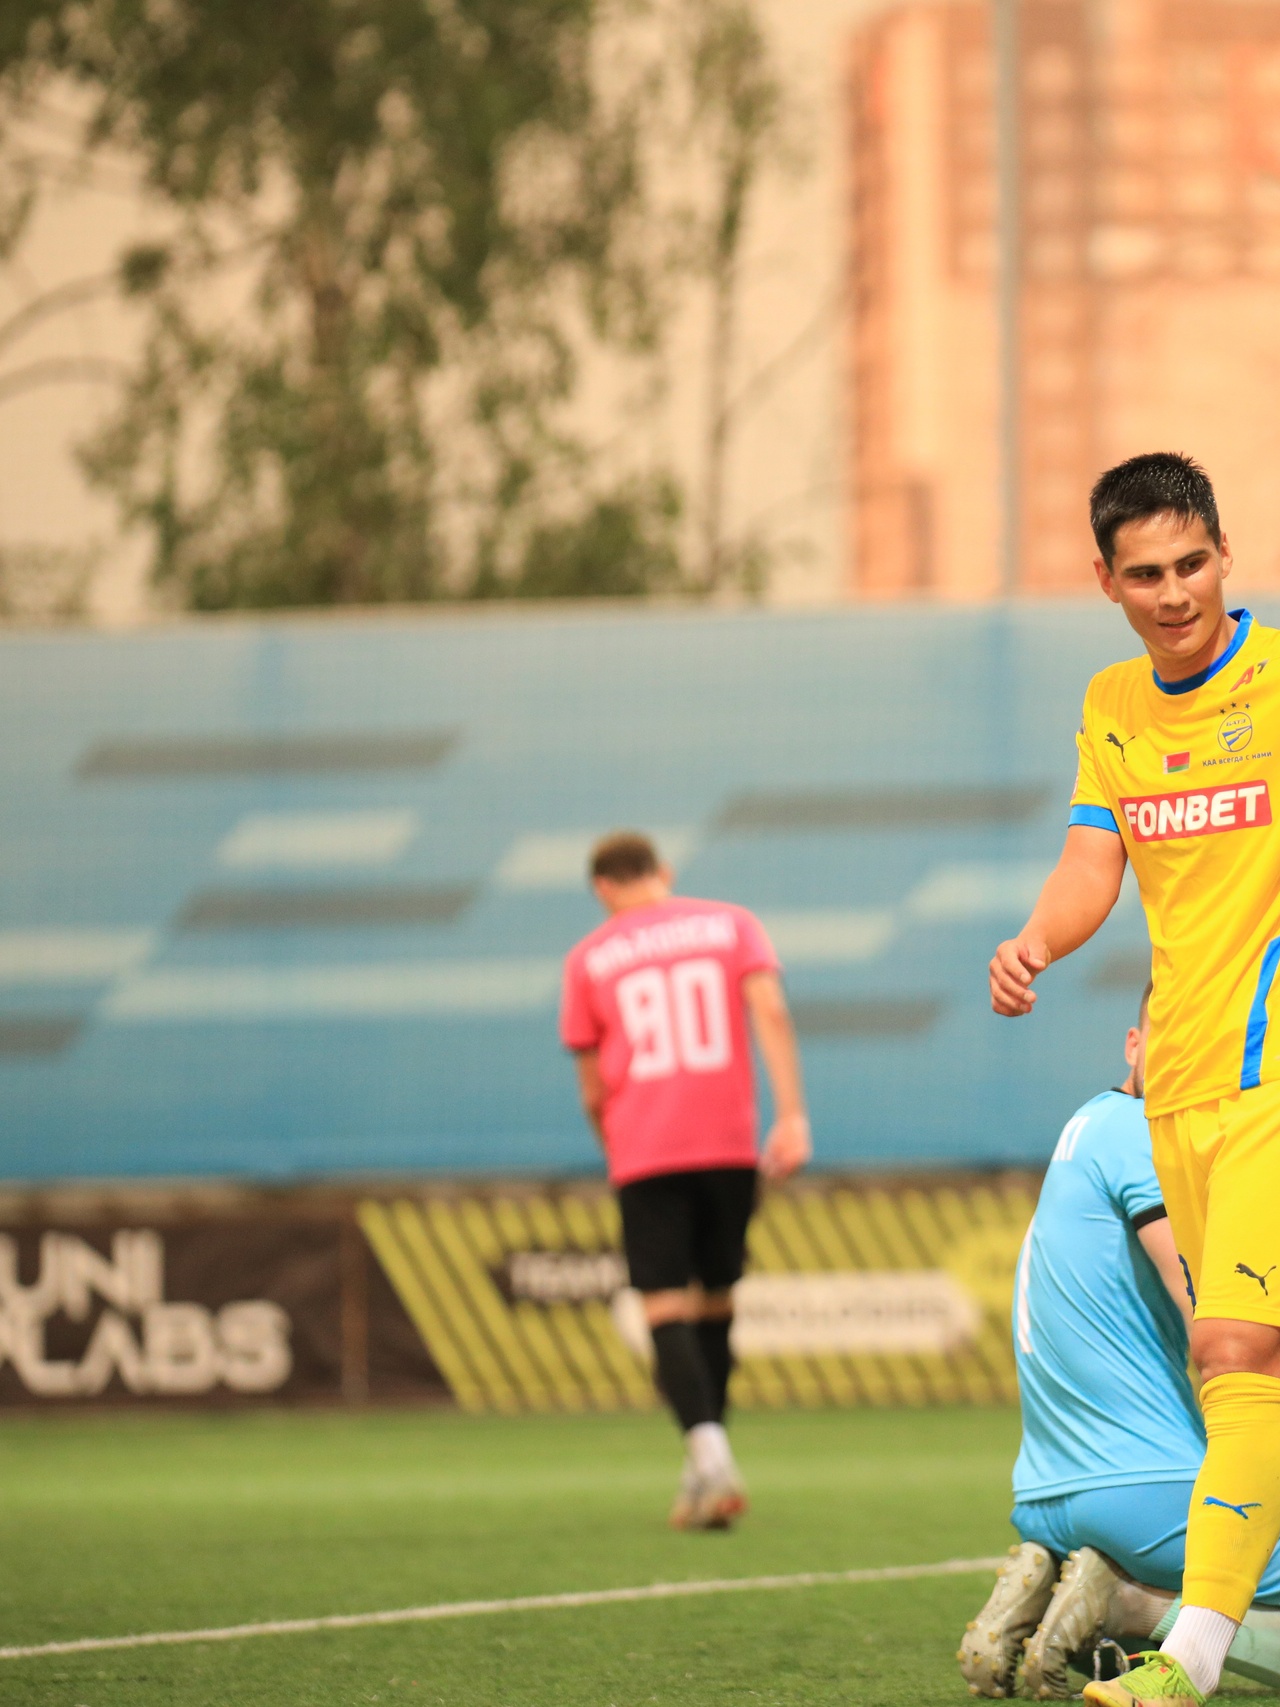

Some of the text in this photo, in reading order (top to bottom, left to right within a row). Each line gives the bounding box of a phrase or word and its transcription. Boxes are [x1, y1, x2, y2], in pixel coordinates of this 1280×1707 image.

[1219, 755, 1243, 765] всегда
[1252, 751, 1272, 760] нами
[1124, 785, 1266, 837] FONBET
[617, 957, 732, 1081] 90
[0, 1228, 163, 1322] UNI
